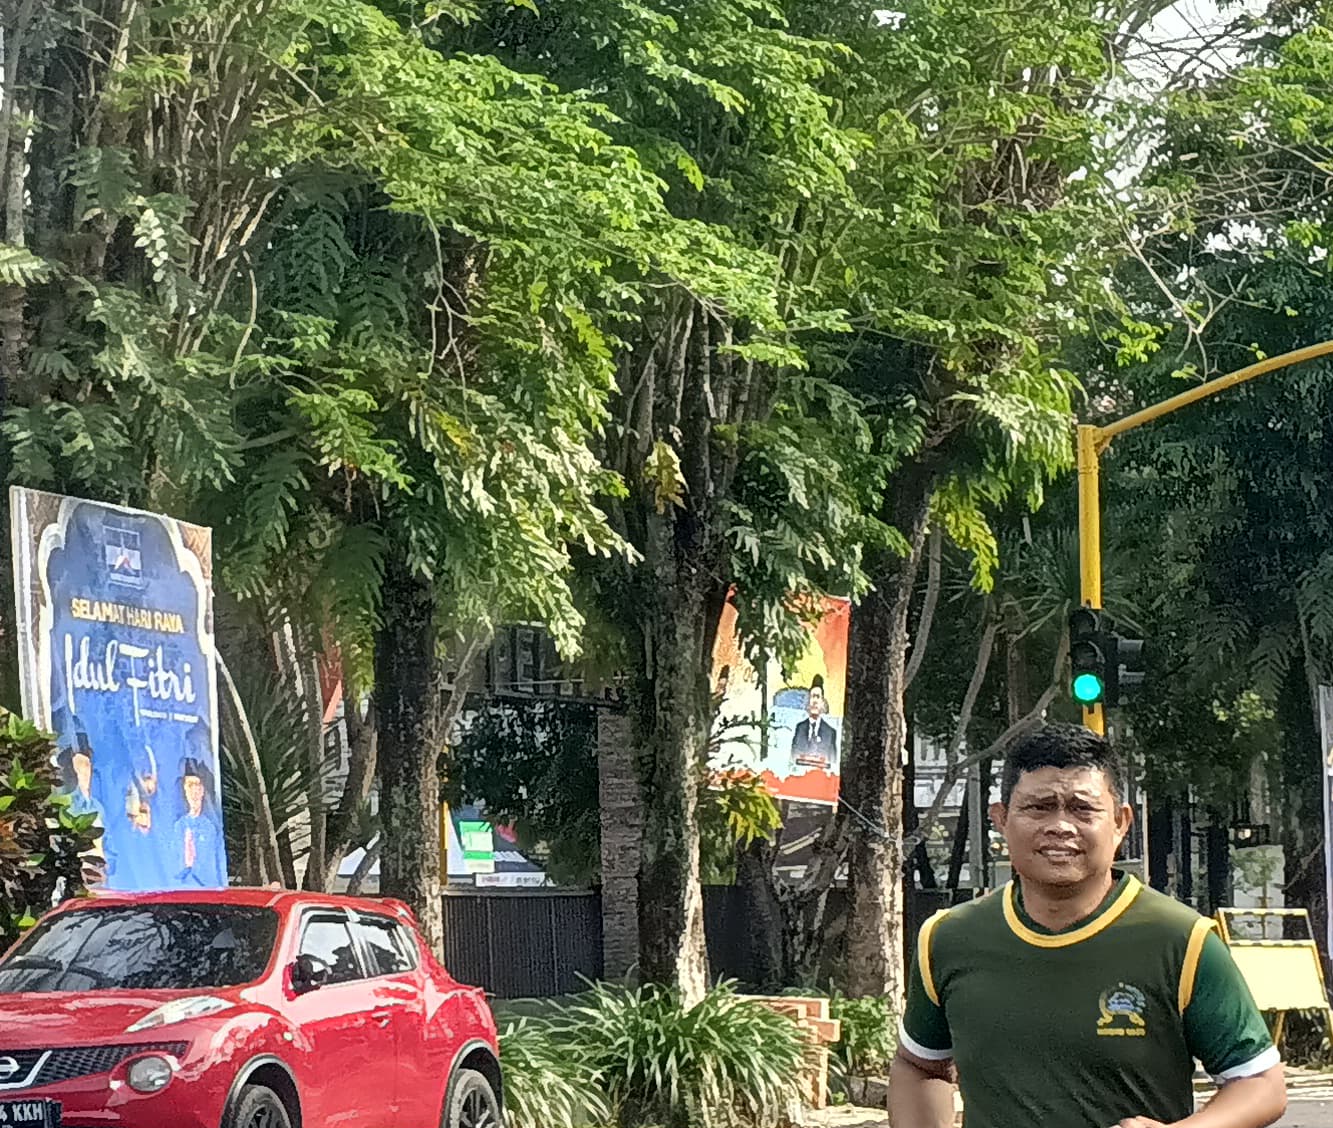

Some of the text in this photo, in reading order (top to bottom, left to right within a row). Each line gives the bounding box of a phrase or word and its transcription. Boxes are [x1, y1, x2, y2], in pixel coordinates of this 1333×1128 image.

[71, 597, 185, 634] SELAMAT HARI RAYA
[65, 633, 196, 727] Idul Fitri
